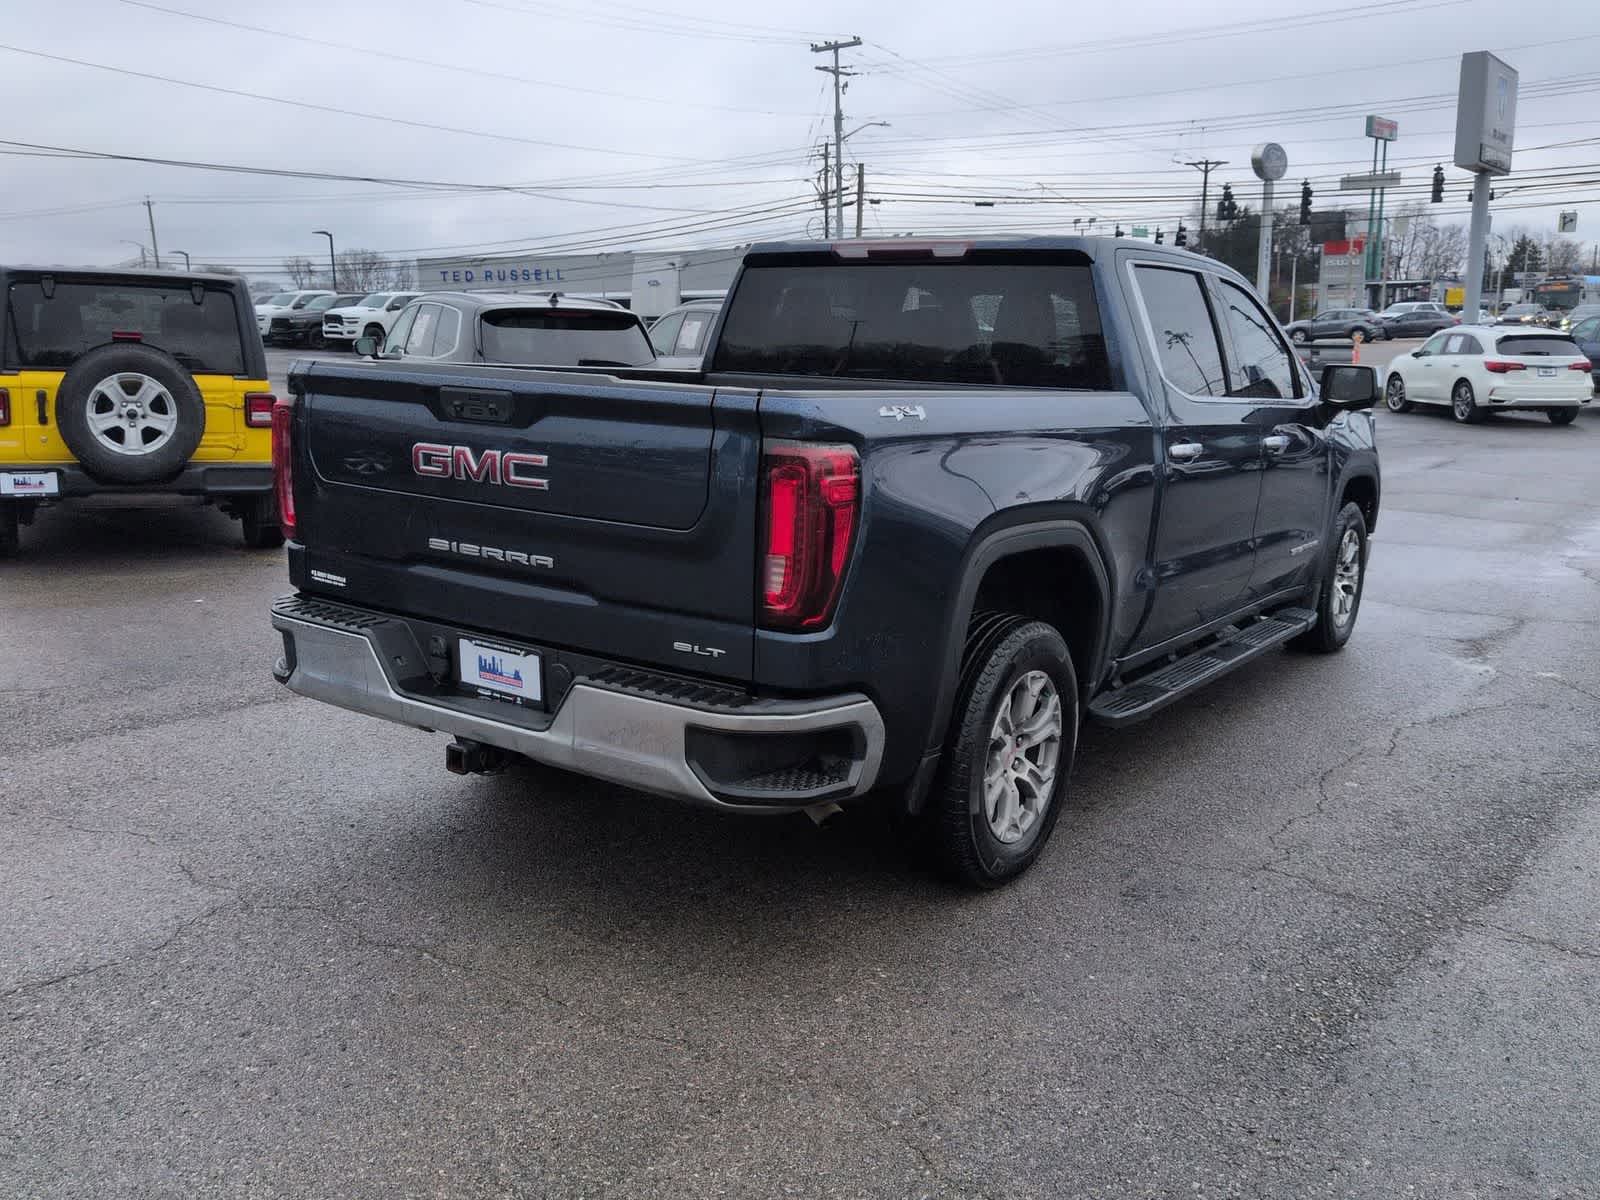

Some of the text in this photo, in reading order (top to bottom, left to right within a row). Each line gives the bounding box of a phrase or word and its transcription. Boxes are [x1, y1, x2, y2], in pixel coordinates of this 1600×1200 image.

[440, 268, 564, 281] TED RUSSELL
[412, 442, 549, 490] GMC
[428, 538, 554, 569] SIERRA
[673, 641, 726, 657] SLT
